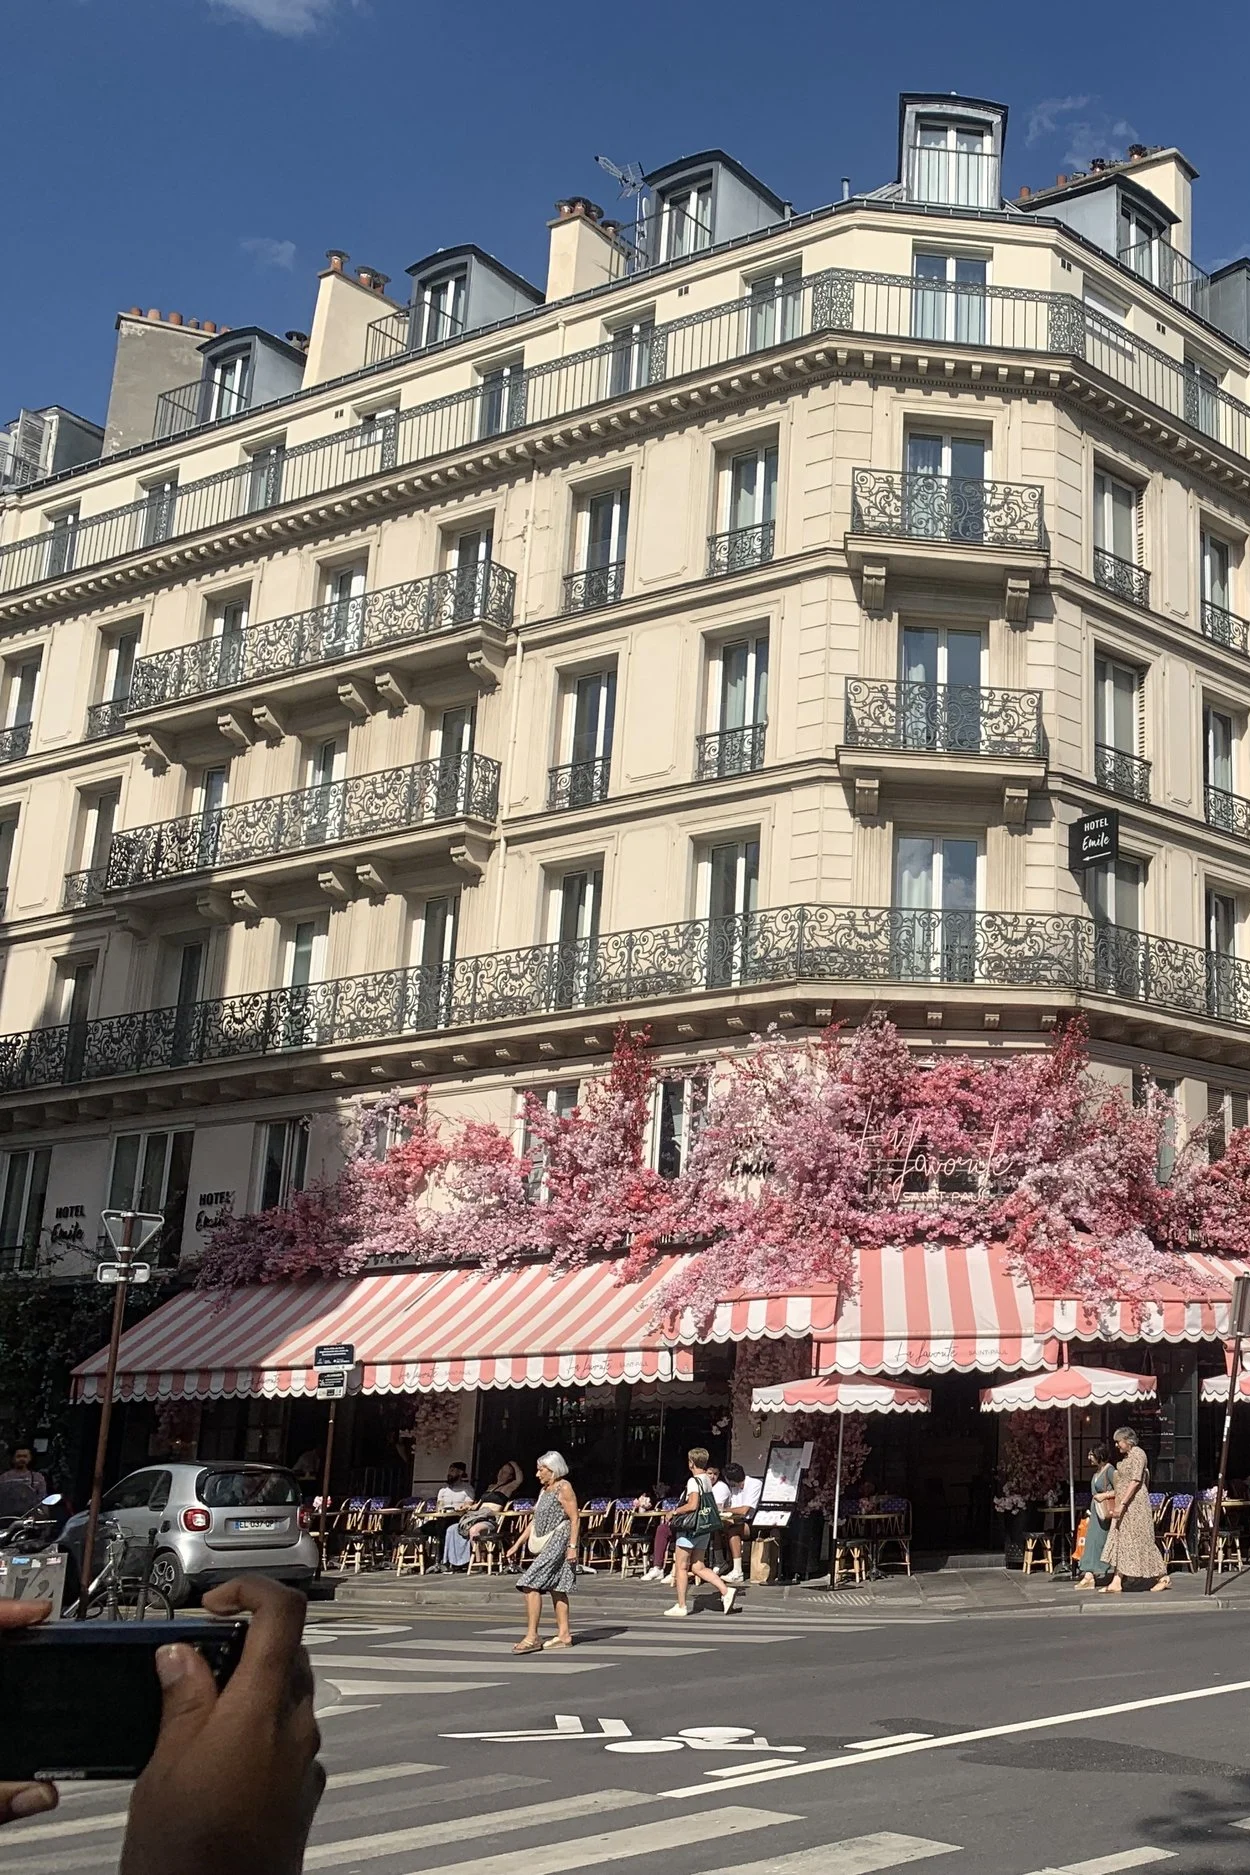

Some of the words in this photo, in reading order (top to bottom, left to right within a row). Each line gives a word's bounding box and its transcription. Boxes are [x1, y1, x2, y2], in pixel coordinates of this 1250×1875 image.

[1084, 817, 1109, 832] HOTEL
[1082, 832, 1110, 851] Emile
[198, 1190, 231, 1206] HOTEL
[55, 1205, 86, 1219] HOTEL
[51, 1221, 85, 1243] Emile
[895, 1341, 914, 1362] La
